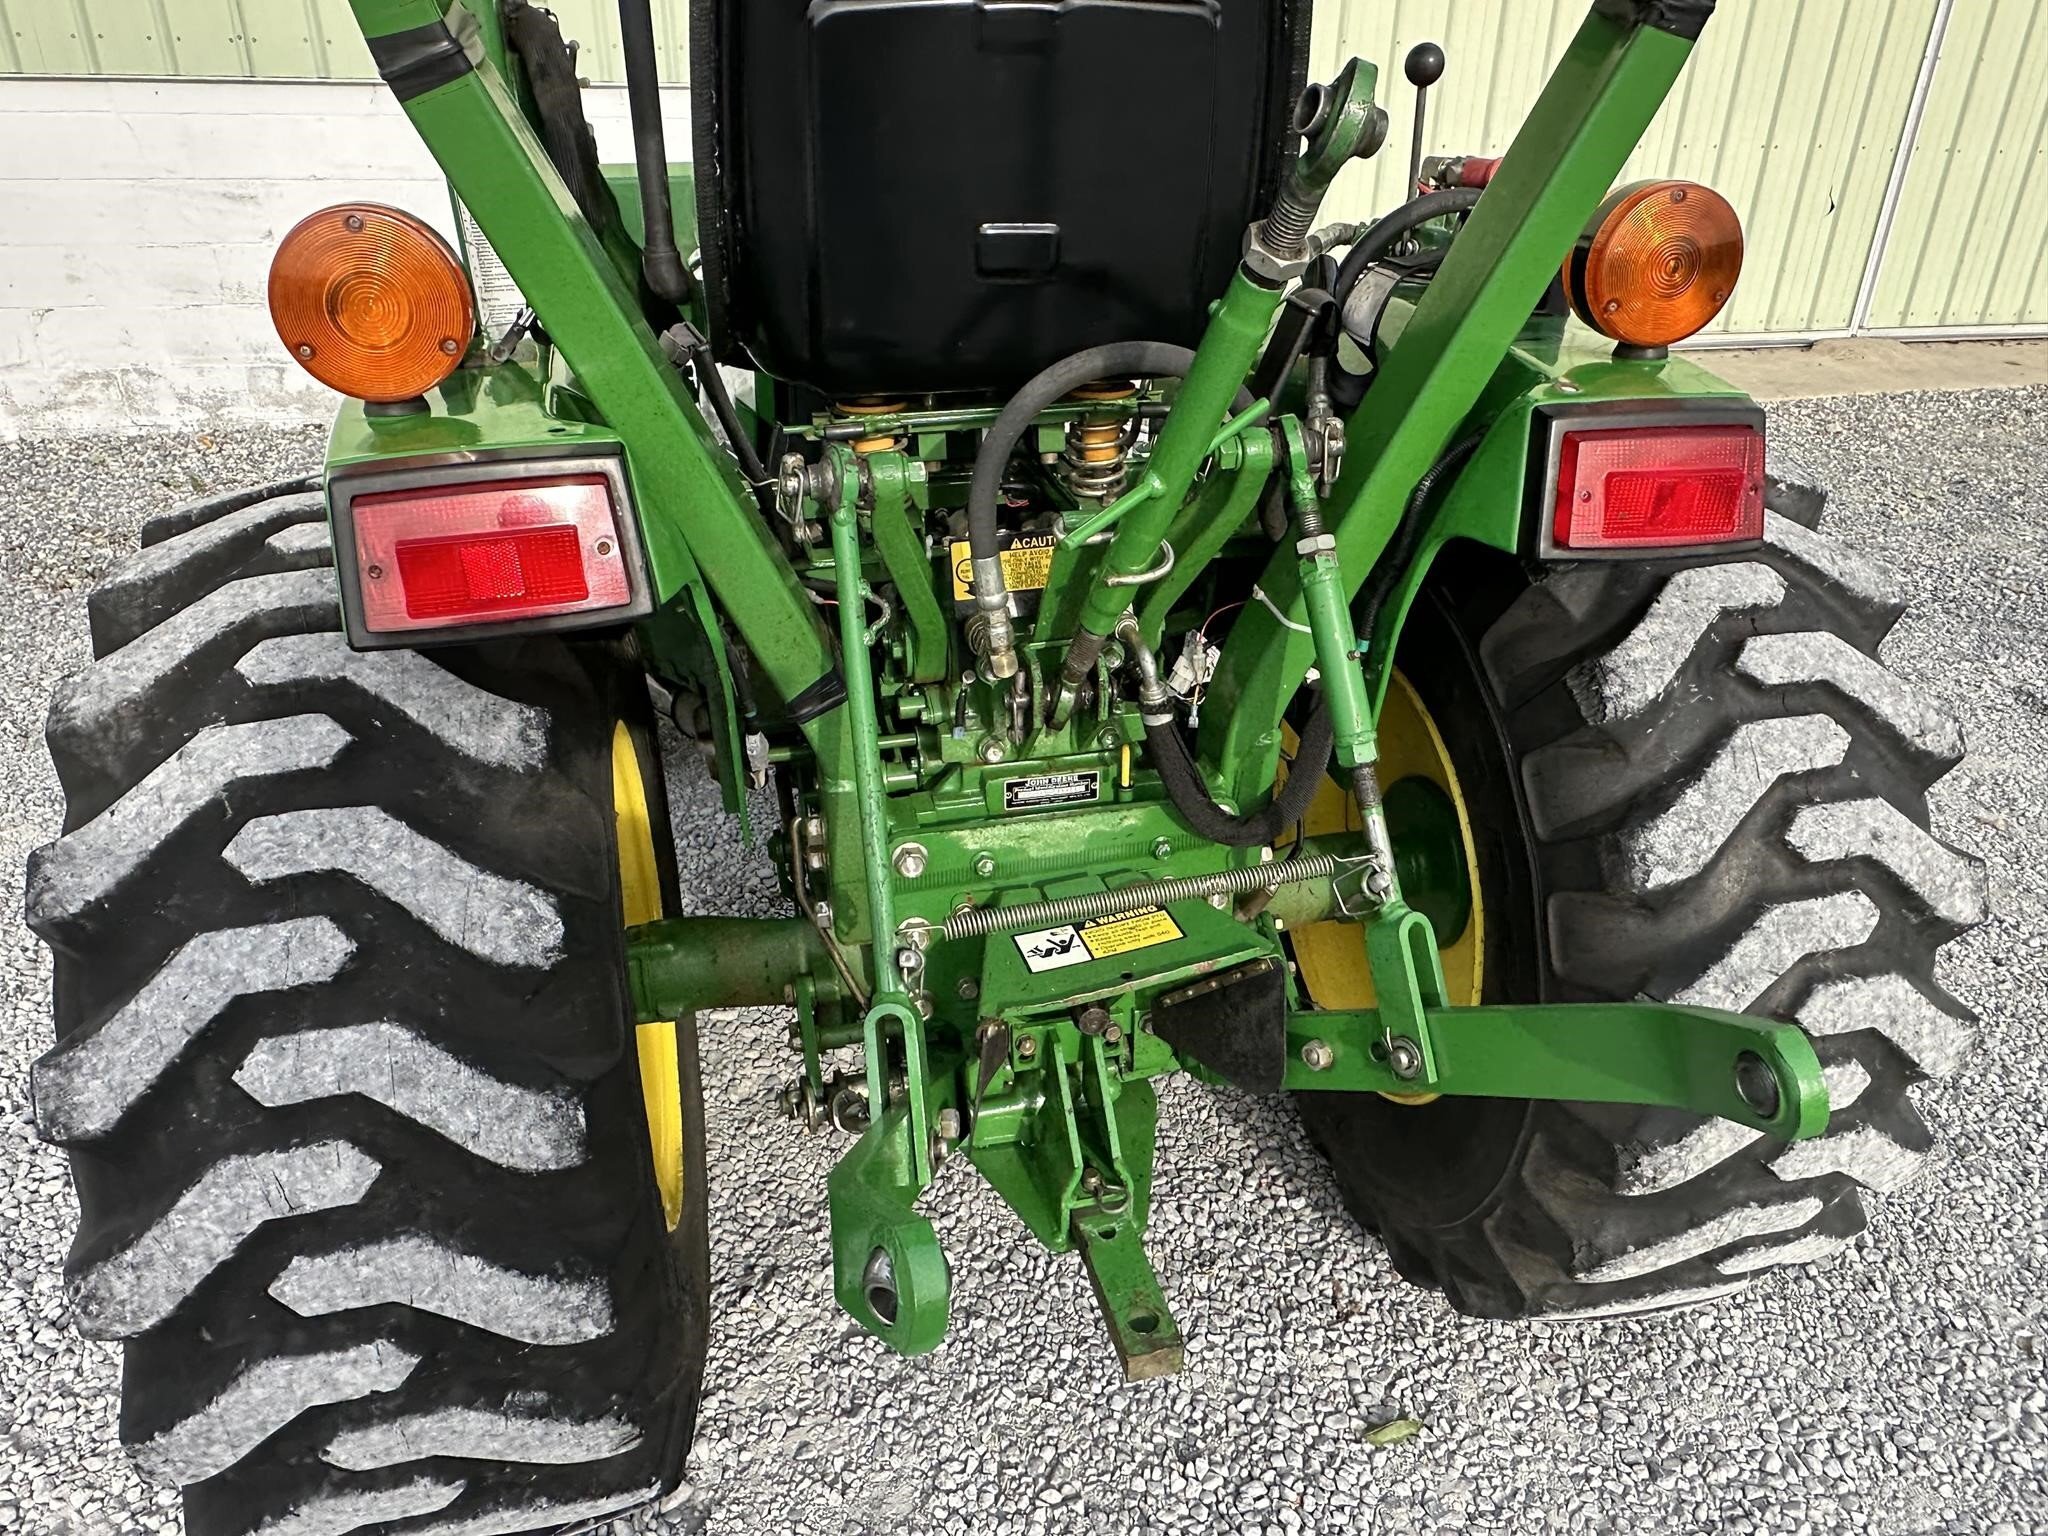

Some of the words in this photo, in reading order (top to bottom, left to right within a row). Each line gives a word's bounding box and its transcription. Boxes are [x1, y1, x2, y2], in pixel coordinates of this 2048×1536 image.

[1025, 778, 1049, 787] JOHN
[1051, 775, 1079, 785] DEERE
[1095, 905, 1158, 925] WARNING
